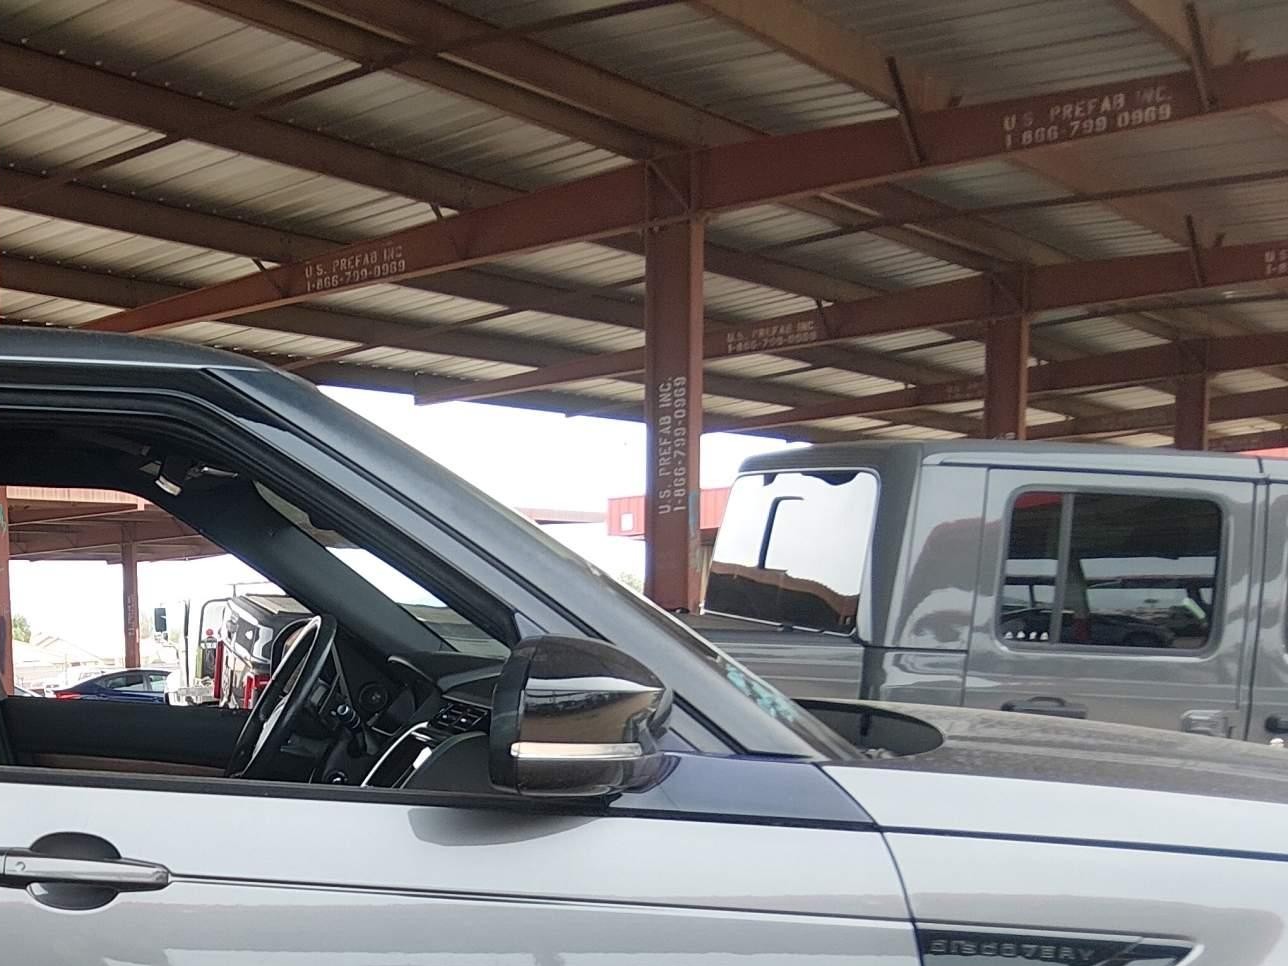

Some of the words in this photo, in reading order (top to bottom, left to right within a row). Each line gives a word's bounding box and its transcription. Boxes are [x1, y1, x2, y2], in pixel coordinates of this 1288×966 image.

[1049, 93, 1125, 121] PREFAB
[332, 251, 378, 273] PREFAB
[658, 376, 673, 409] INC.
[658, 414, 673, 478] PREFAB
[673, 375, 688, 512] 1-866-799-0969
[930, 939, 1095, 961] DISCOVERY
